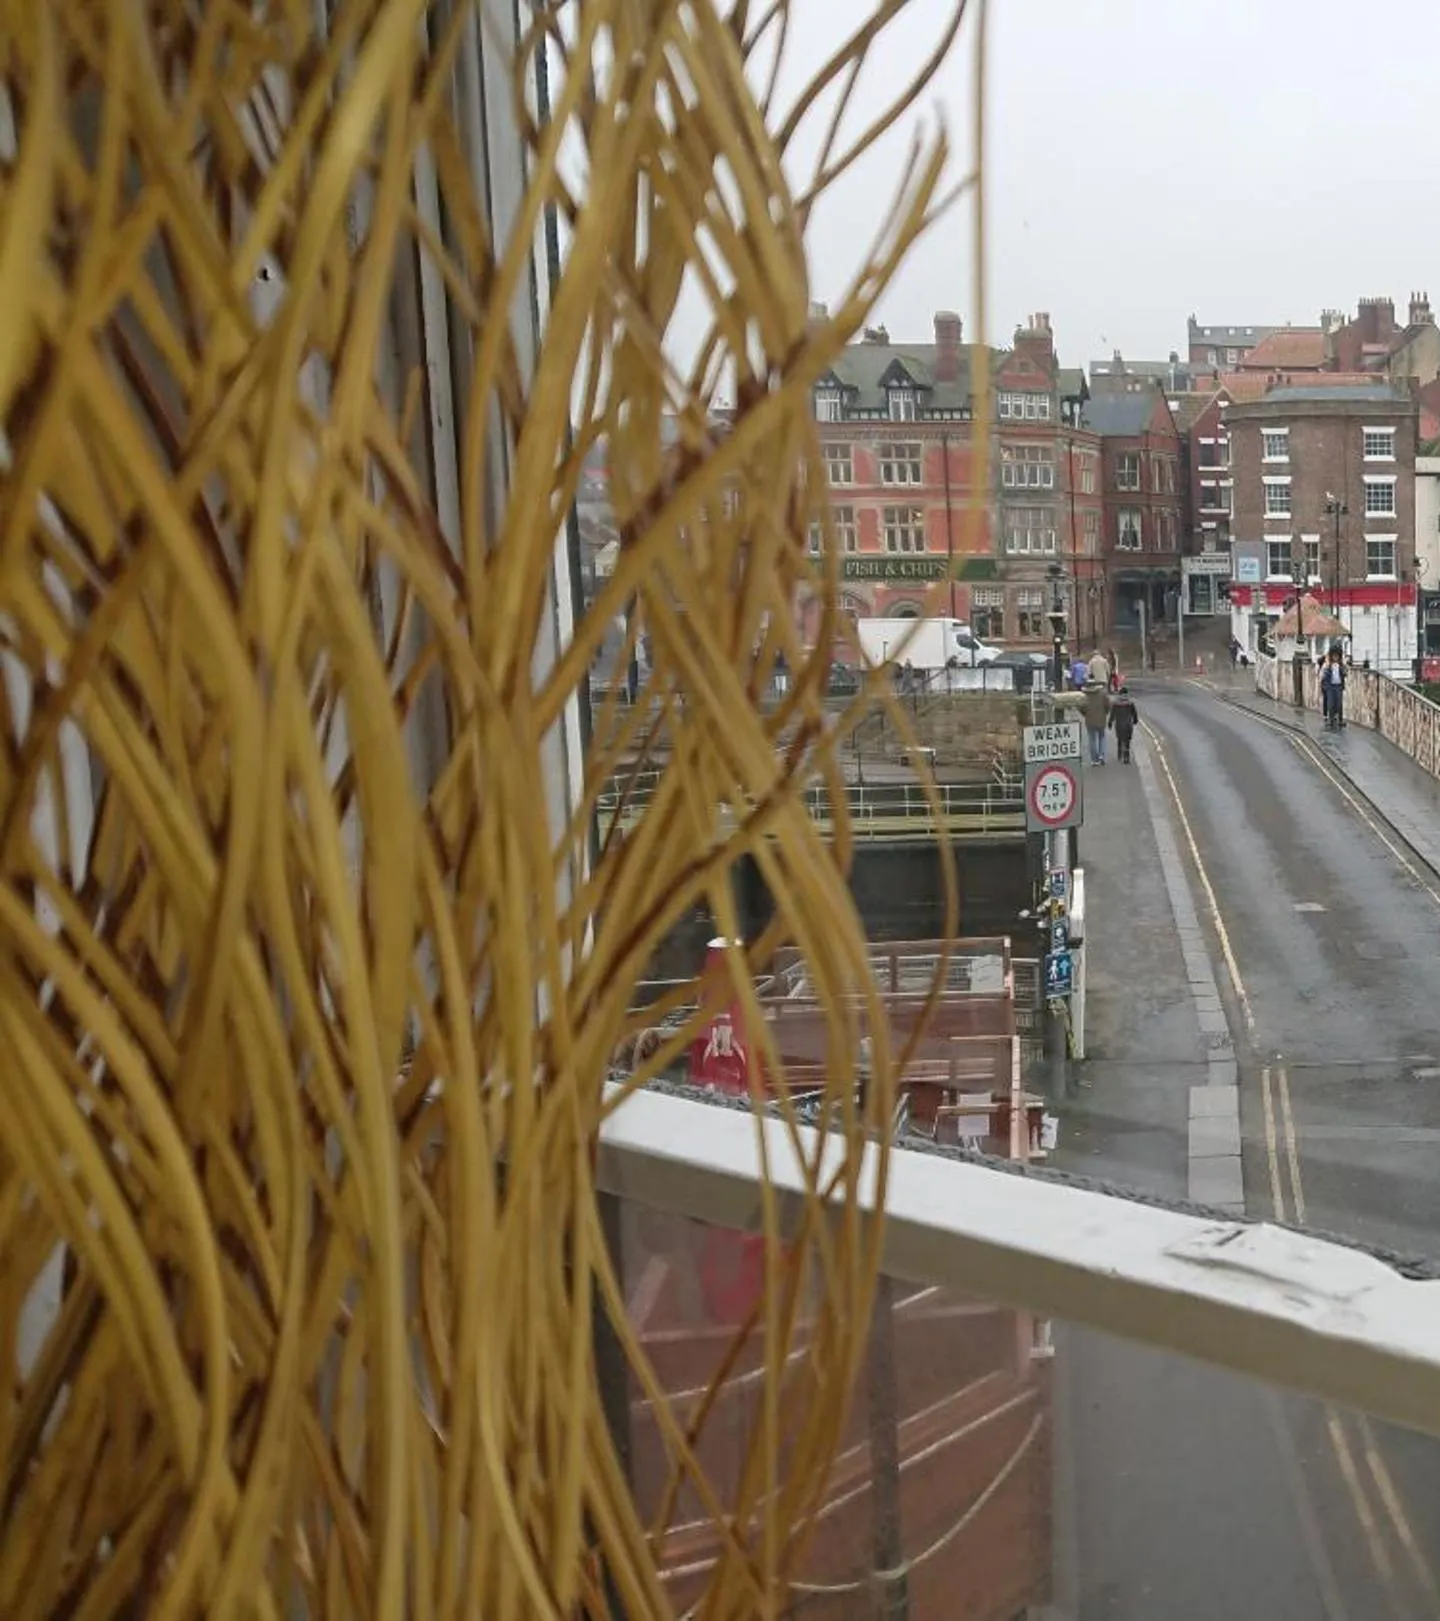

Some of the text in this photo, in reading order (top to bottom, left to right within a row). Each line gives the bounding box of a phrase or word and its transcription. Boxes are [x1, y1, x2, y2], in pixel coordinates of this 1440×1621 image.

[846, 561, 879, 576] FISH
[884, 561, 897, 576] &
[1033, 726, 1071, 741] WEAK
[1028, 741, 1077, 758] BRIDGE
